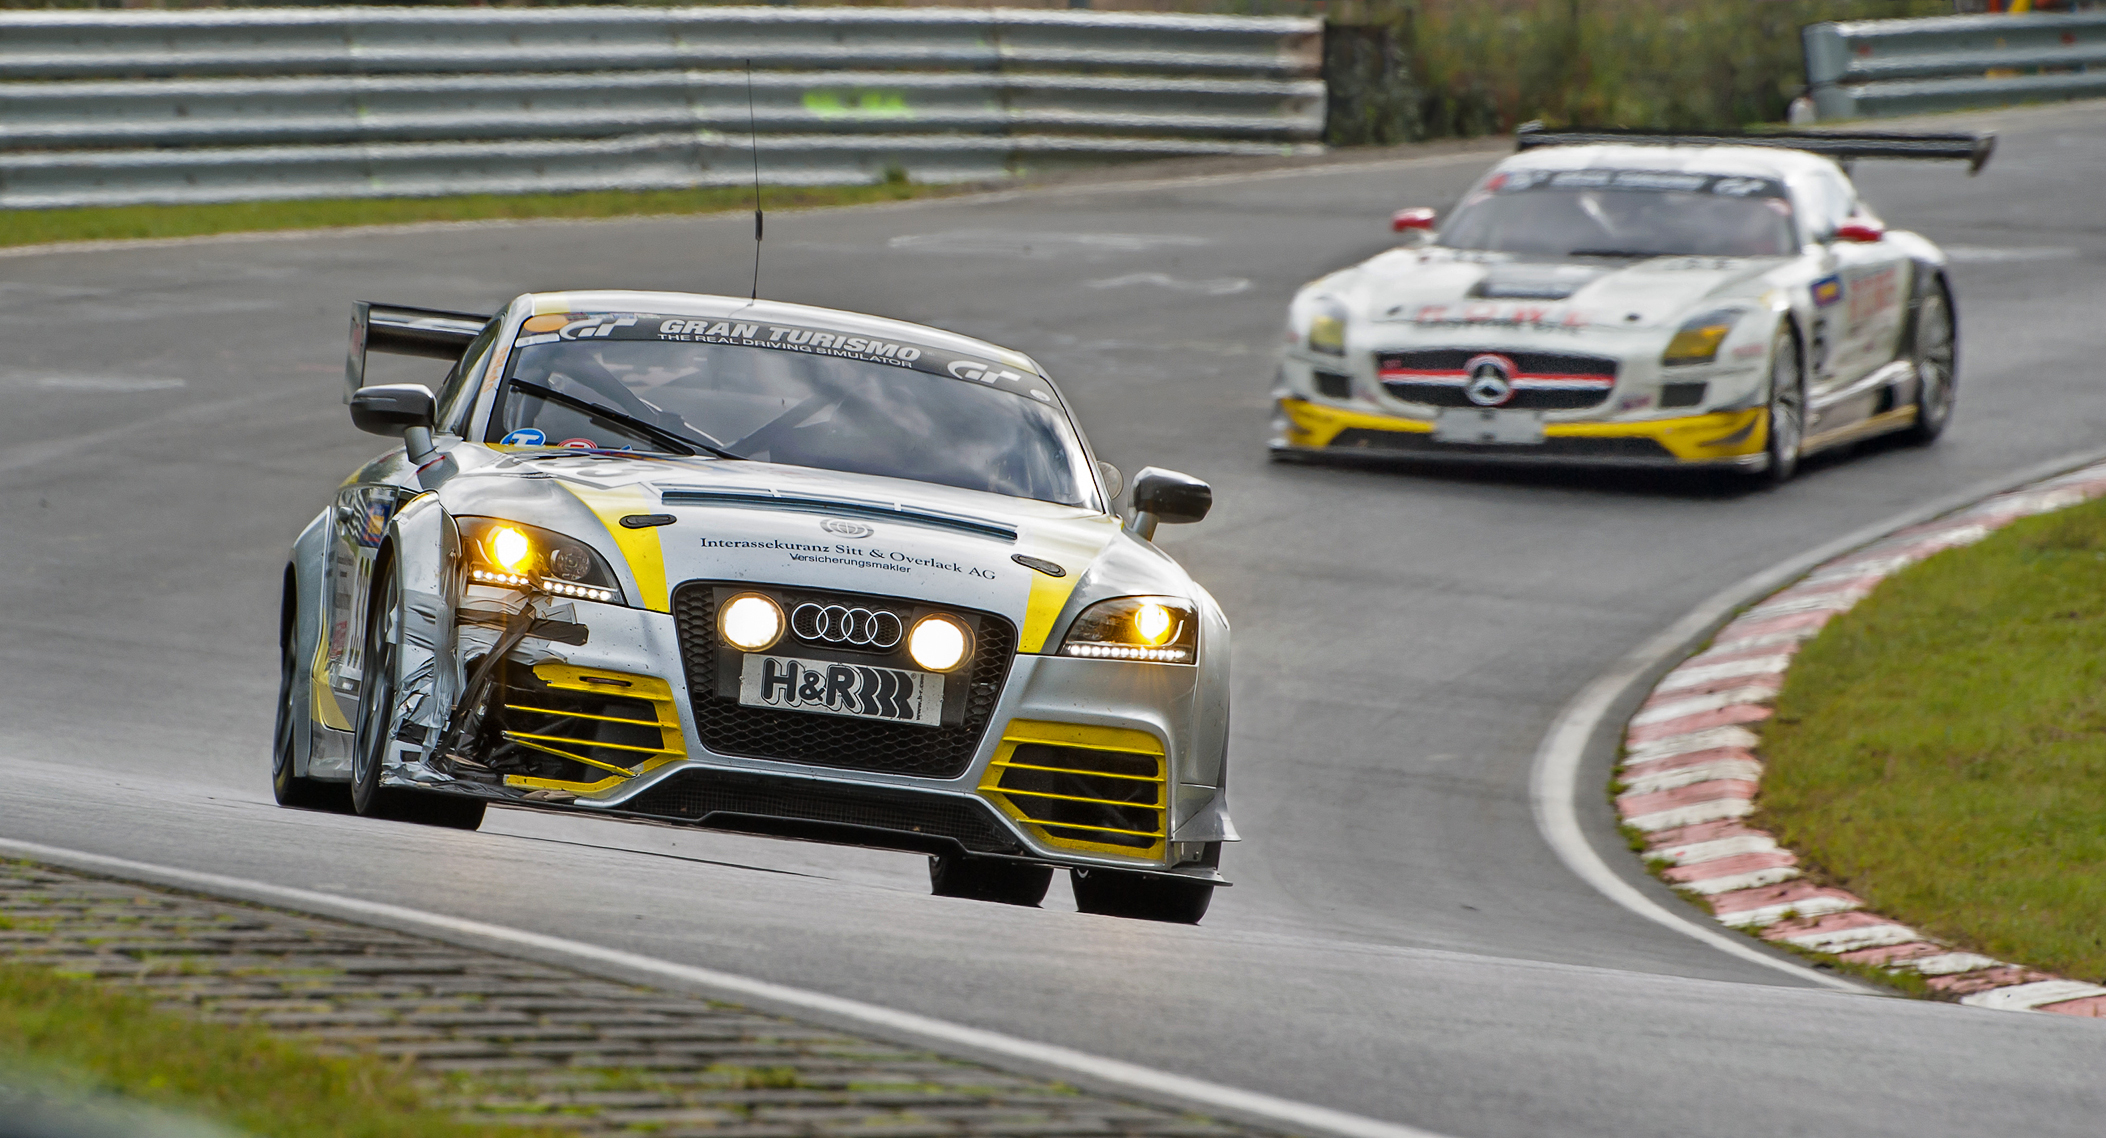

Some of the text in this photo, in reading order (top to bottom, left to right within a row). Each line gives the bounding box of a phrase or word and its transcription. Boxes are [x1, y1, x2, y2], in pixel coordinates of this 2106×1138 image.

[657, 333, 691, 342] THE
[694, 335, 739, 345] REAL
[743, 338, 812, 353] DRIVING
[816, 347, 913, 369] SIMULATOR
[659, 319, 921, 362] GRAN TURISMO
[947, 360, 1021, 384] GT
[700, 538, 996, 580] Interassekuranz Sitt & Overlack AG
[789, 553, 912, 574] Versicherungsmakler
